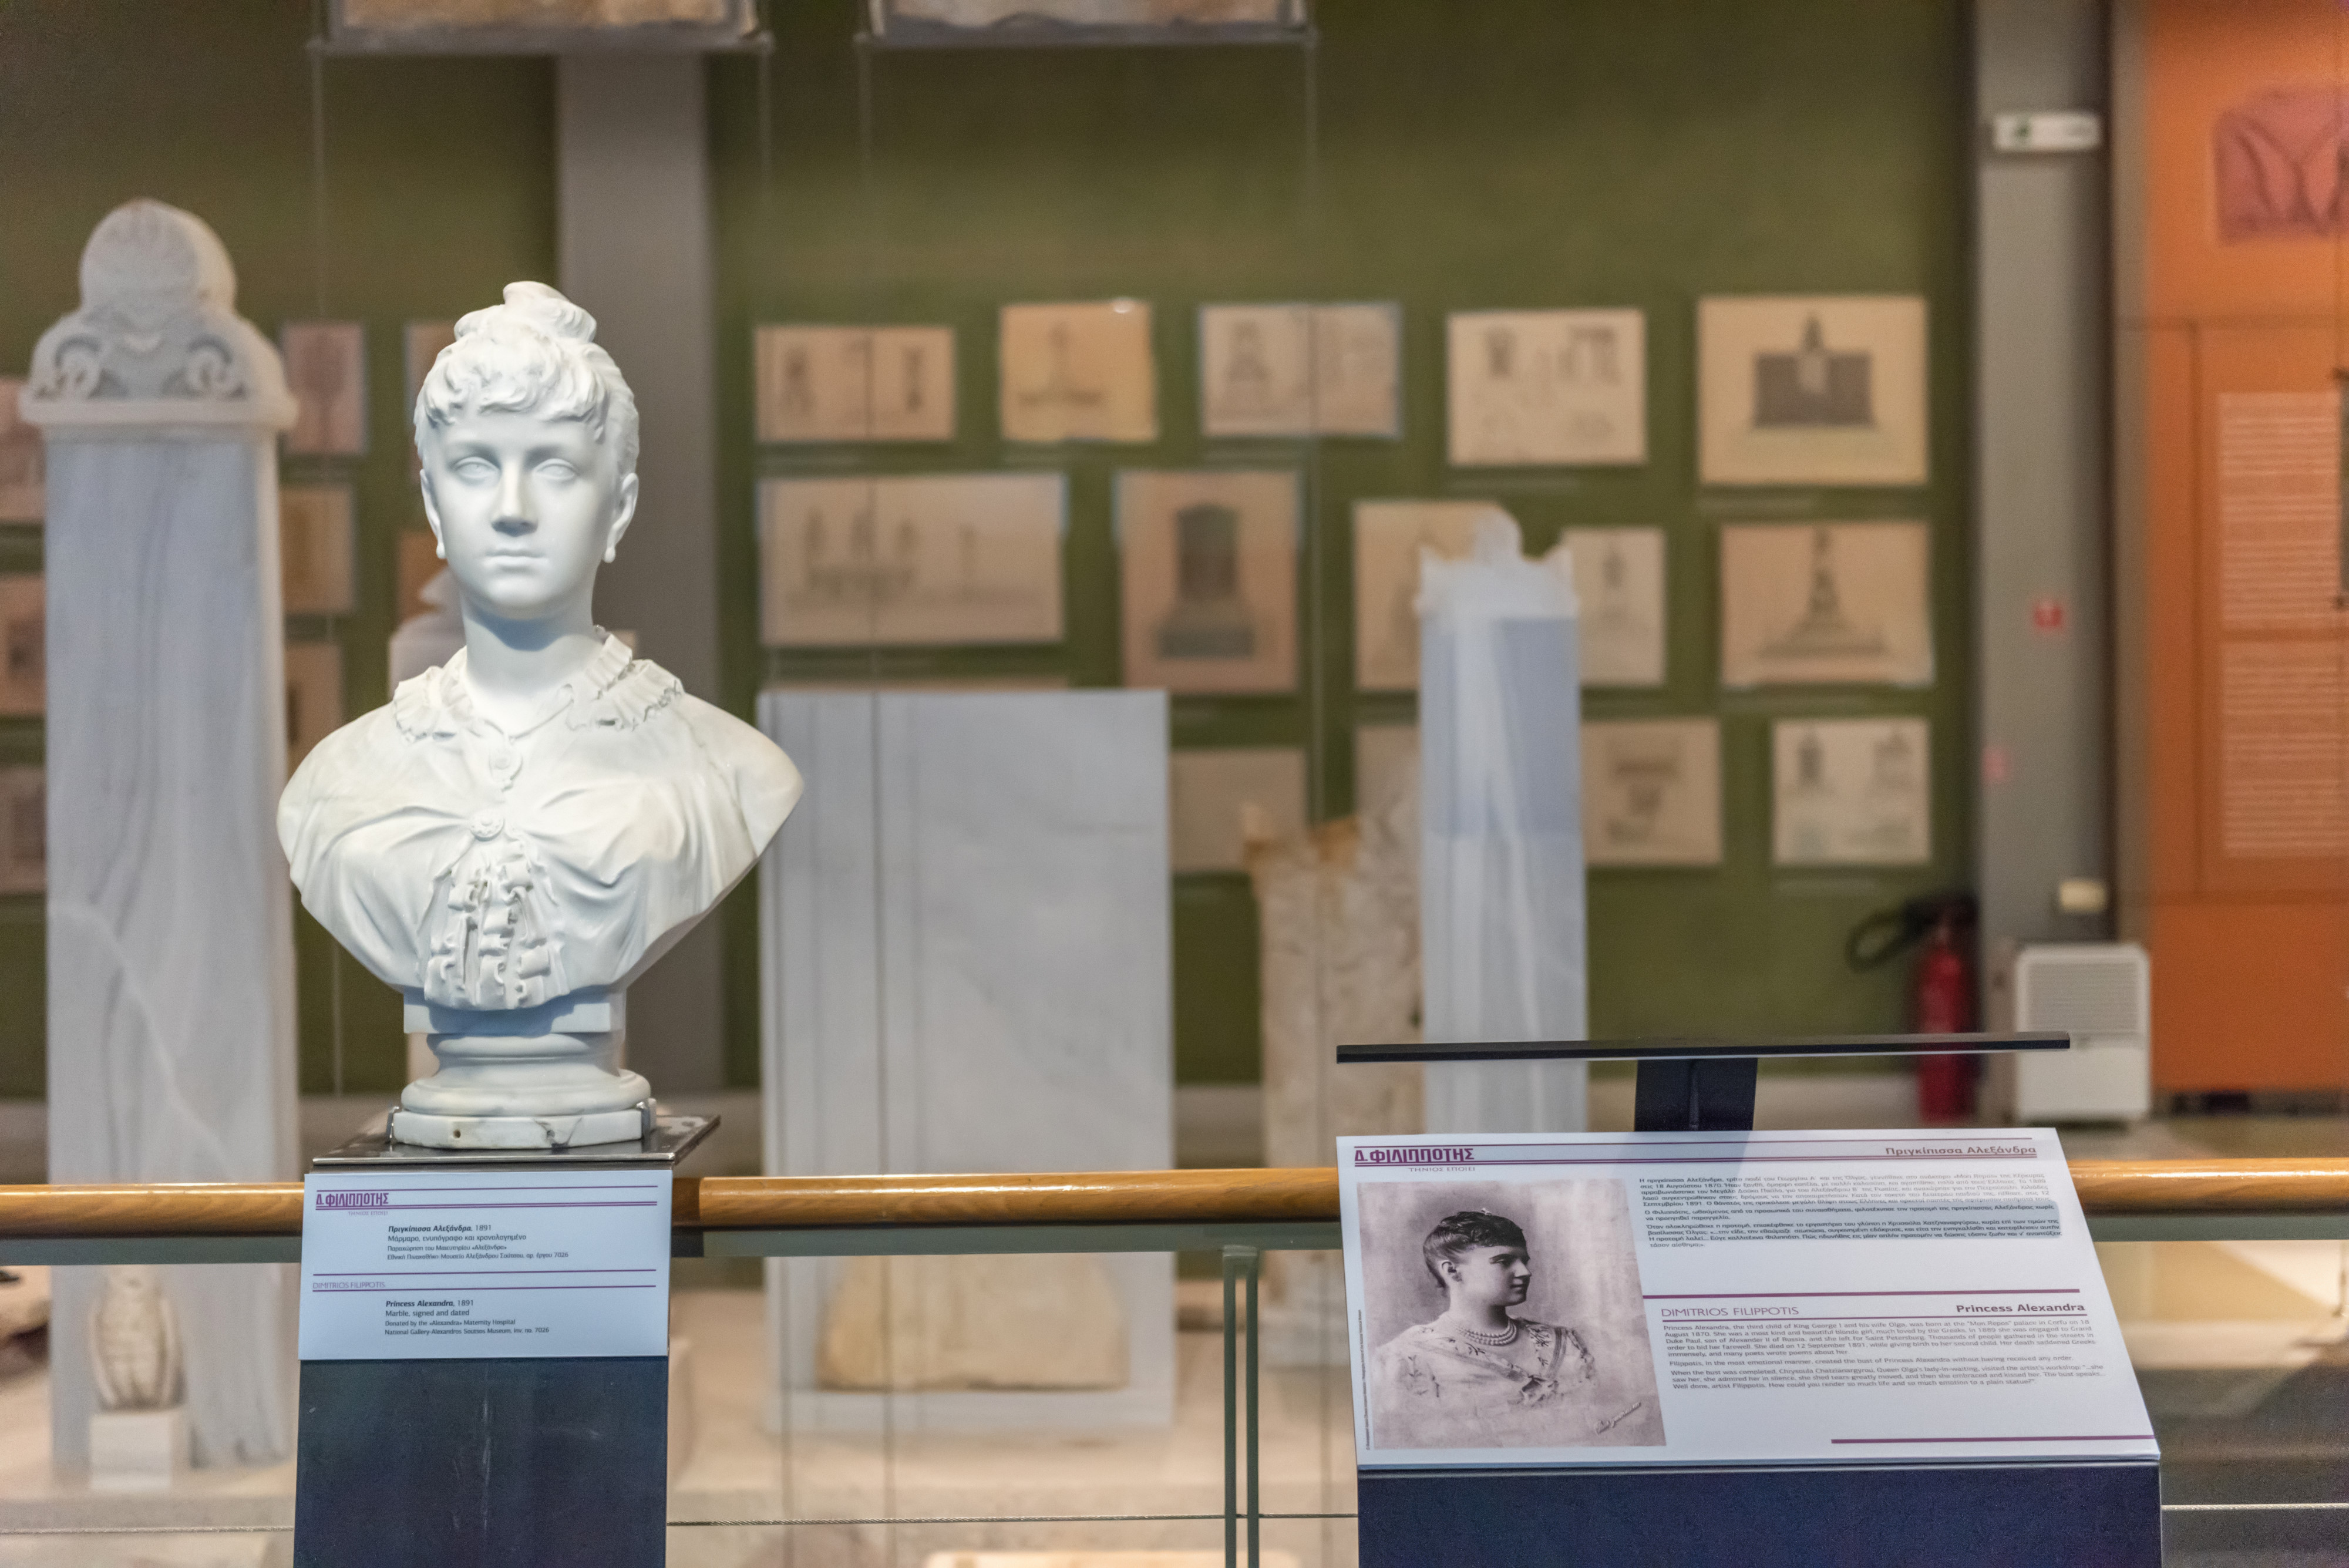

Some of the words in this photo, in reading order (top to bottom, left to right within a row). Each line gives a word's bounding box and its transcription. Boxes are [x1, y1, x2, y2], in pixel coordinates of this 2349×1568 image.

[1886, 1148, 1963, 1156] Πριγκίπισσα
[1967, 1146, 2036, 1155] Αλεξάνδρα
[388, 1225, 432, 1233] Πριγκίπισσα
[422, 1234, 463, 1243] ενυπόγραφο
[476, 1233, 527, 1242] χρονολογημένο
[1661, 1308, 1728, 1317] DIMITRIOS
[1733, 1307, 1799, 1315] FILIPPOTIS
[1956, 1303, 2013, 1313] Princess
[2017, 1303, 2085, 1311] Alexandra
[412, 1310, 435, 1318] signed
